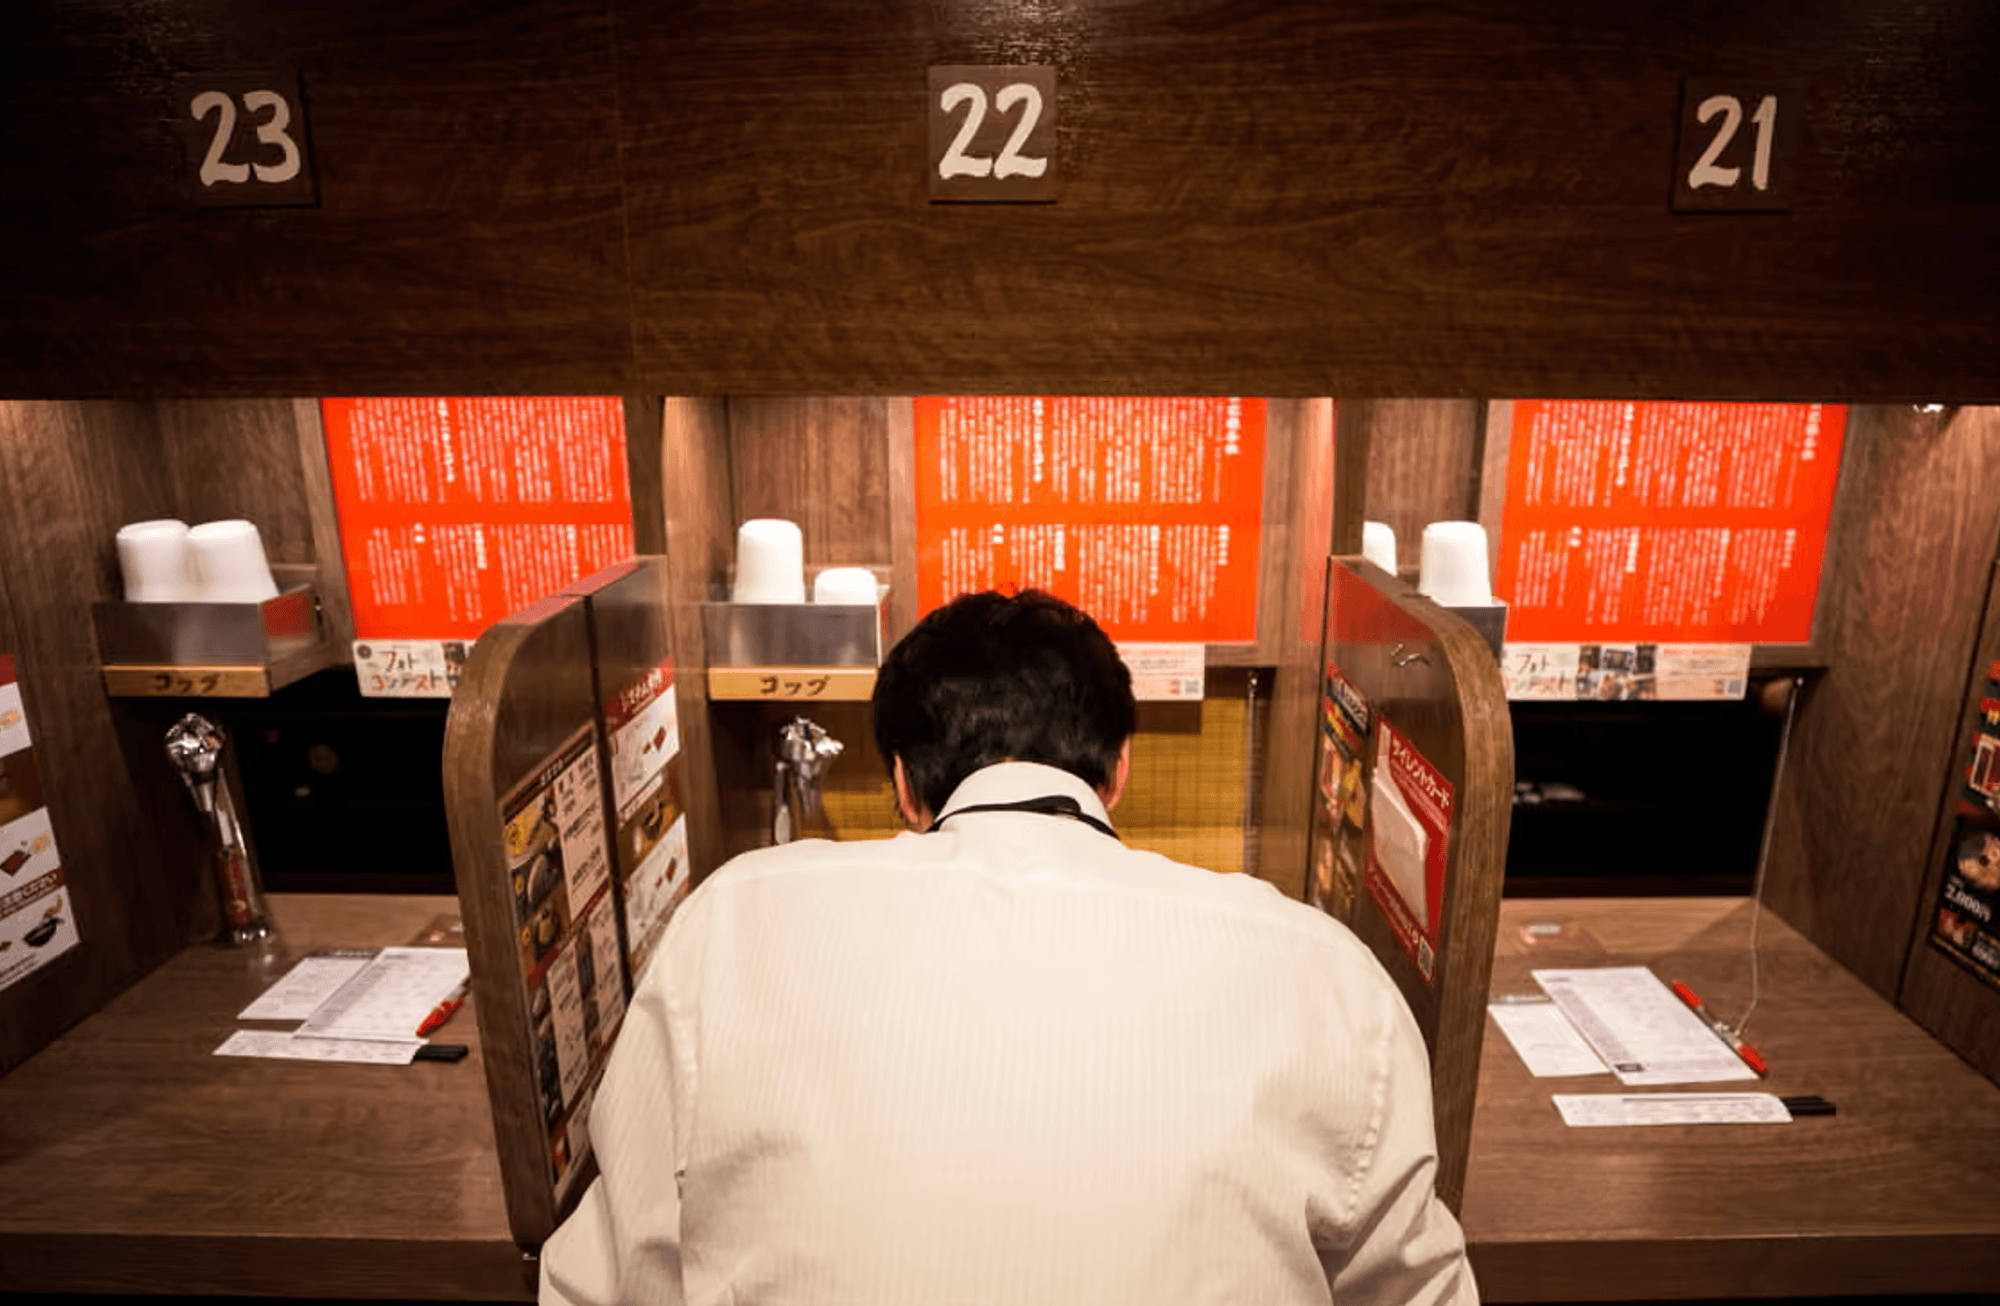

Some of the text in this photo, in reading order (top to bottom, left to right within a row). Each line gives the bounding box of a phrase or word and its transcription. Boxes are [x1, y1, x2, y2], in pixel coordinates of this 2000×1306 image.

[190, 90, 301, 187] 23
[938, 82, 1048, 180] 22
[1687, 94, 1778, 191] 21
[760, 674, 831, 697] コップ
